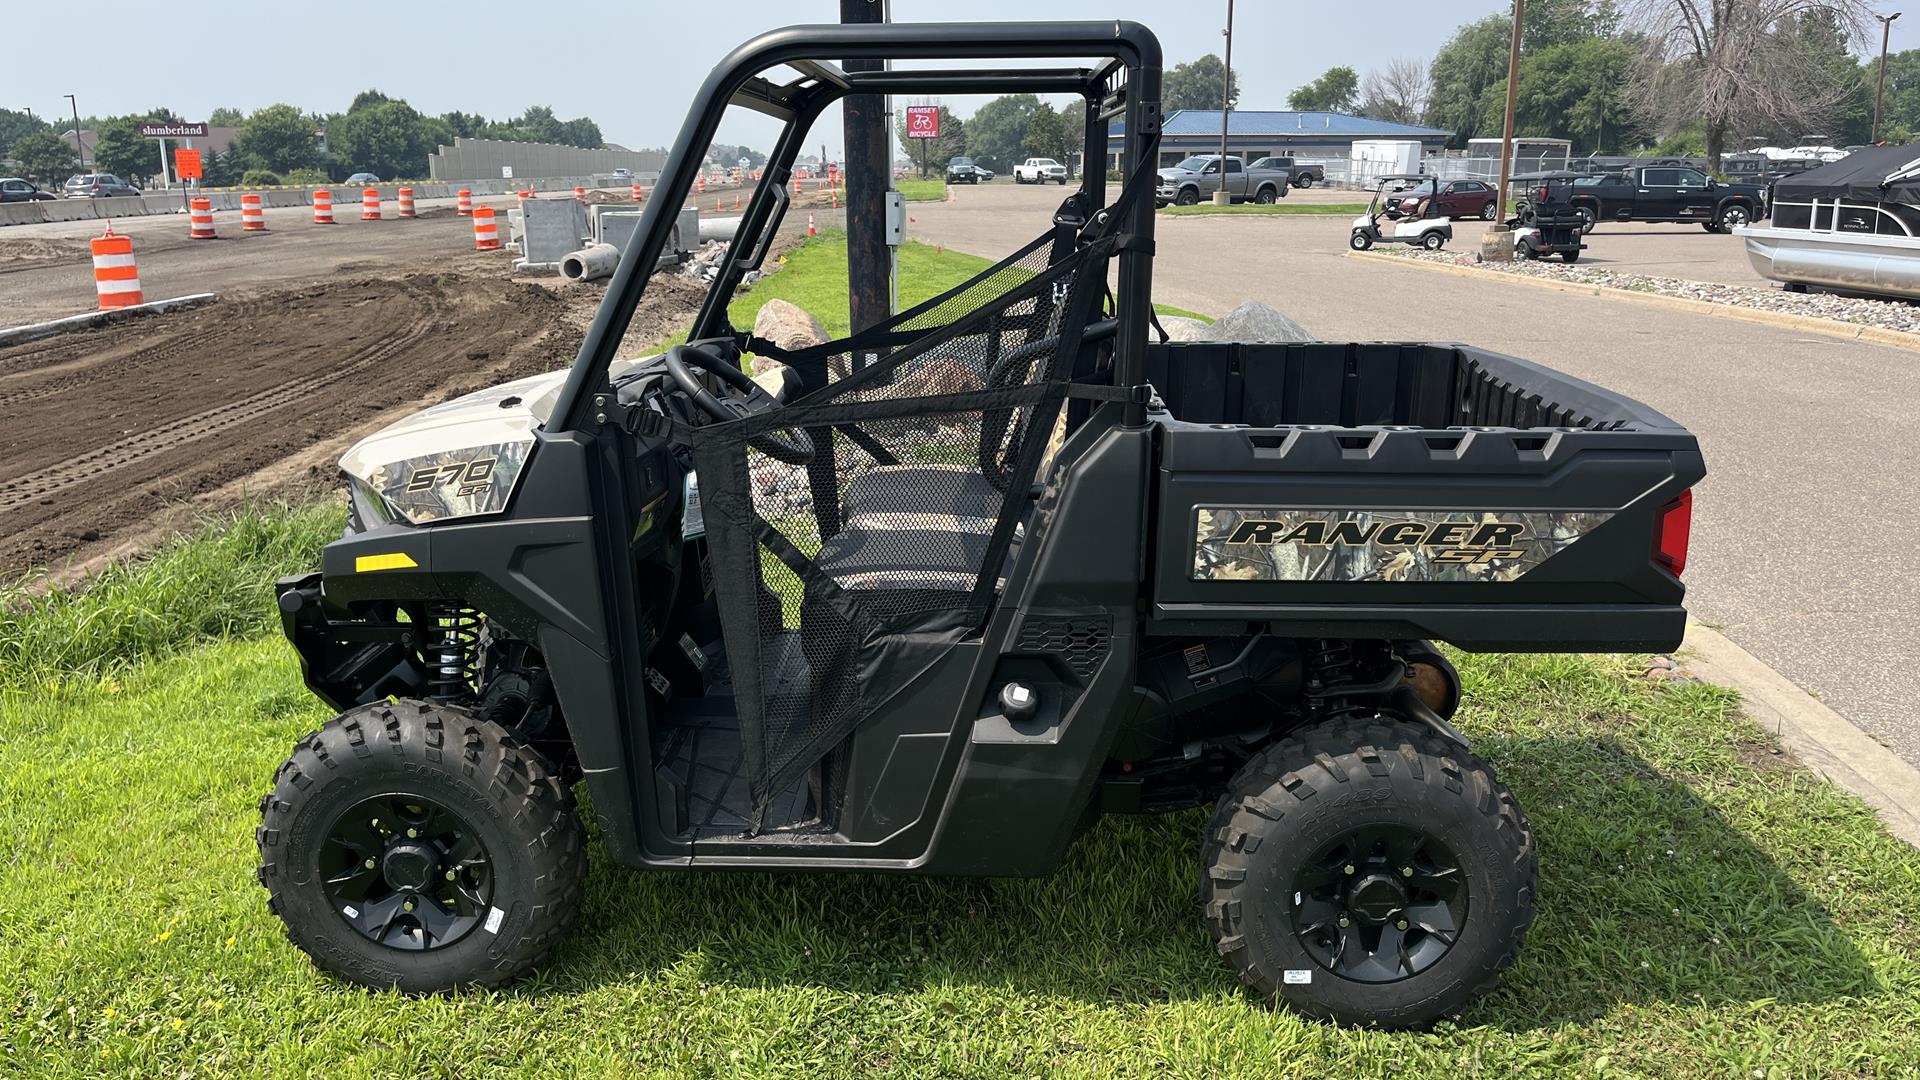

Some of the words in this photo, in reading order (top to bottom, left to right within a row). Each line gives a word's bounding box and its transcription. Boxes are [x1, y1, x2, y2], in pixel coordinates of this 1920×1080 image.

[142, 125, 203, 135] slumberland
[406, 458, 497, 493] 570
[457, 483, 493, 497] EFI
[1225, 520, 1527, 547] RANGER
[1432, 549, 1528, 564] SP
